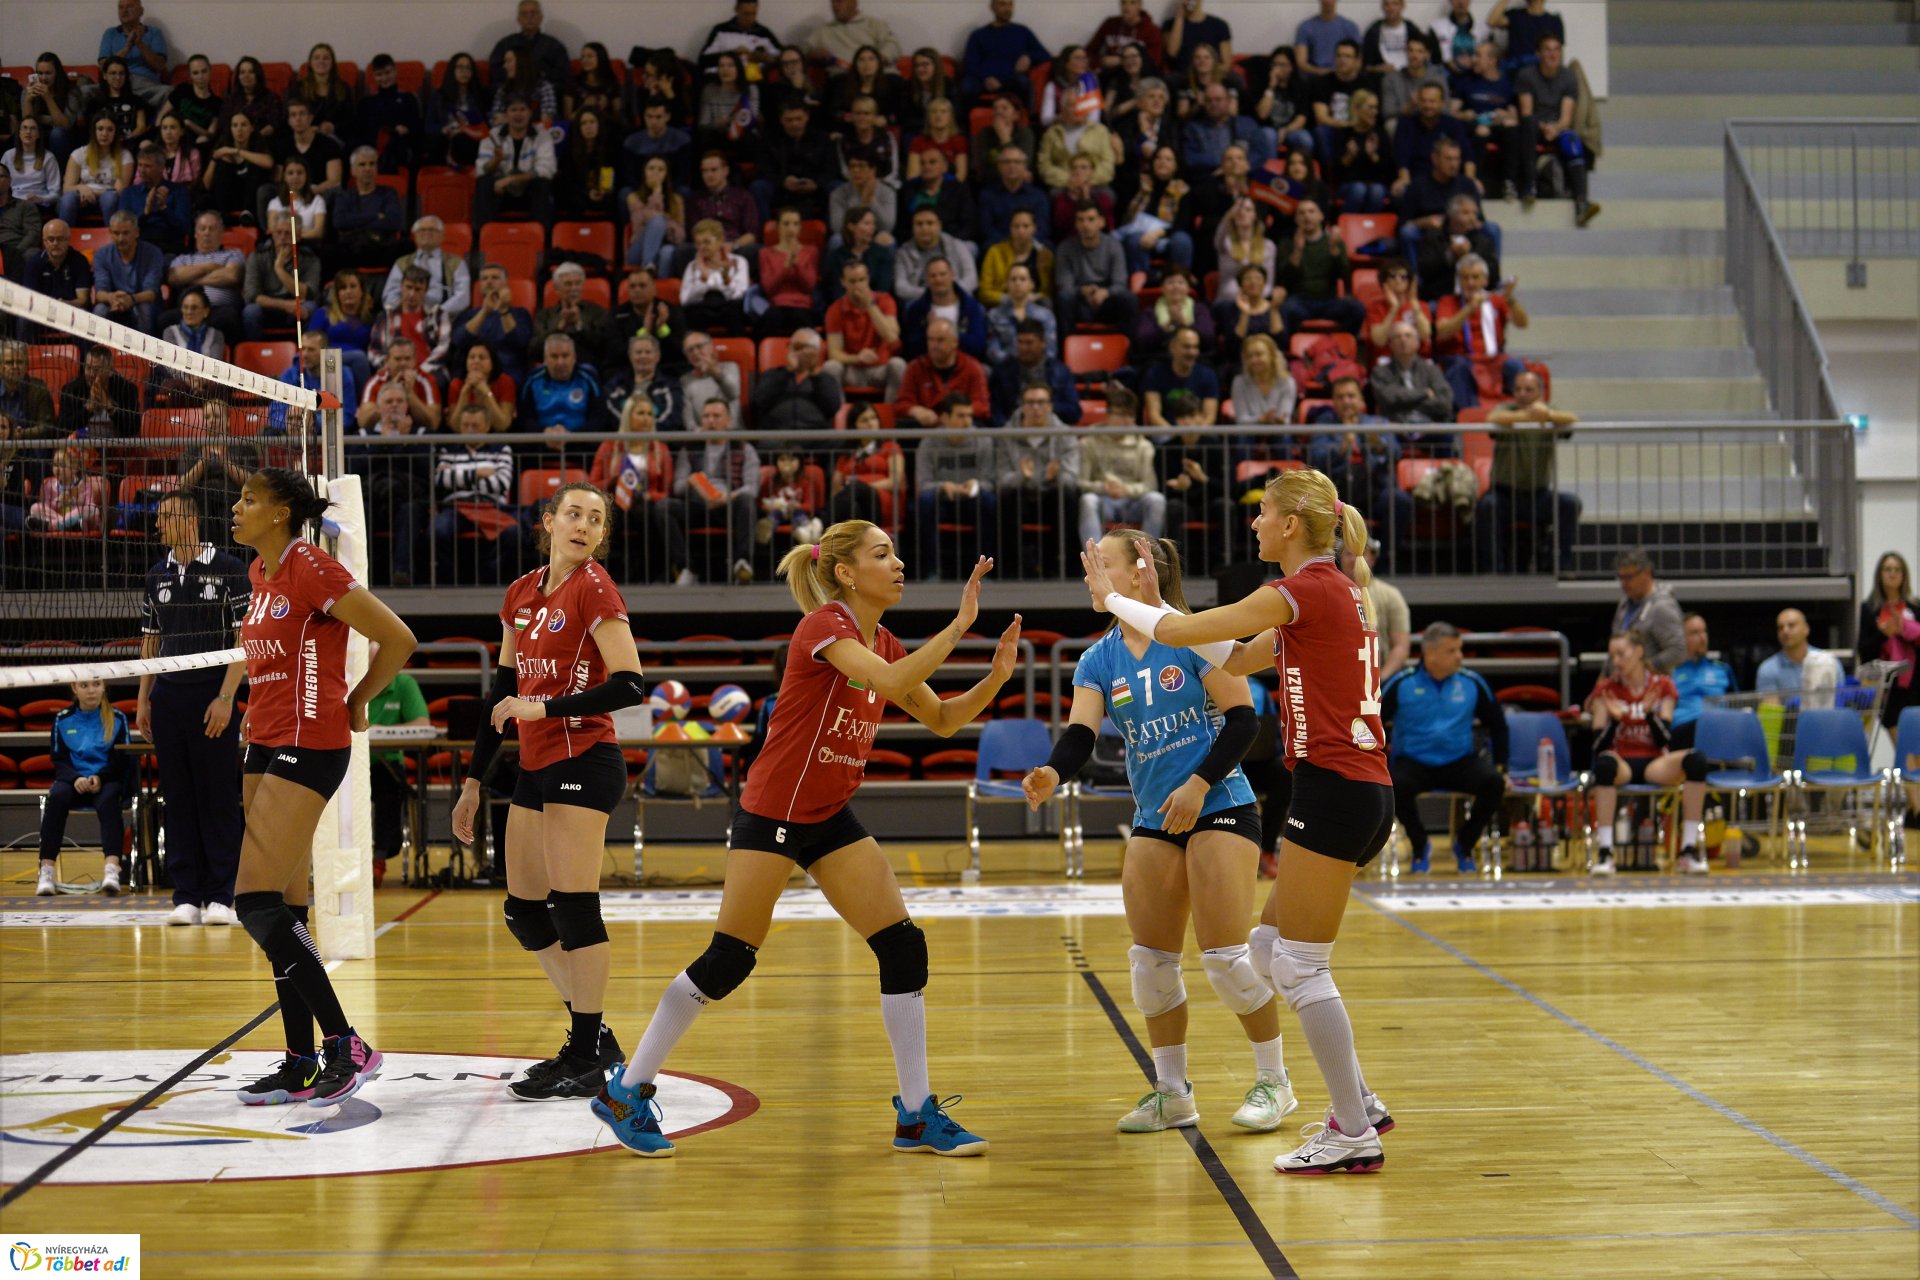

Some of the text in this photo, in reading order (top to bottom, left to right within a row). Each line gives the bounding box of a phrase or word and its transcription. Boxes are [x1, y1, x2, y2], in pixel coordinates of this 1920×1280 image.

[248, 592, 271, 625] 14
[530, 607, 548, 640] 2
[243, 639, 285, 656] ATUM
[302, 638, 318, 719] NYÍREGYHÁZA
[1136, 667, 1153, 707] 7
[1123, 706, 1200, 745] FATUM
[1286, 667, 1308, 758] NYÍREGYHÁZA
[277, 753, 298, 764] JAKO
[560, 783, 582, 791] JAKO
[1213, 816, 1236, 825] JAKO
[1287, 816, 1305, 830] JAKO
